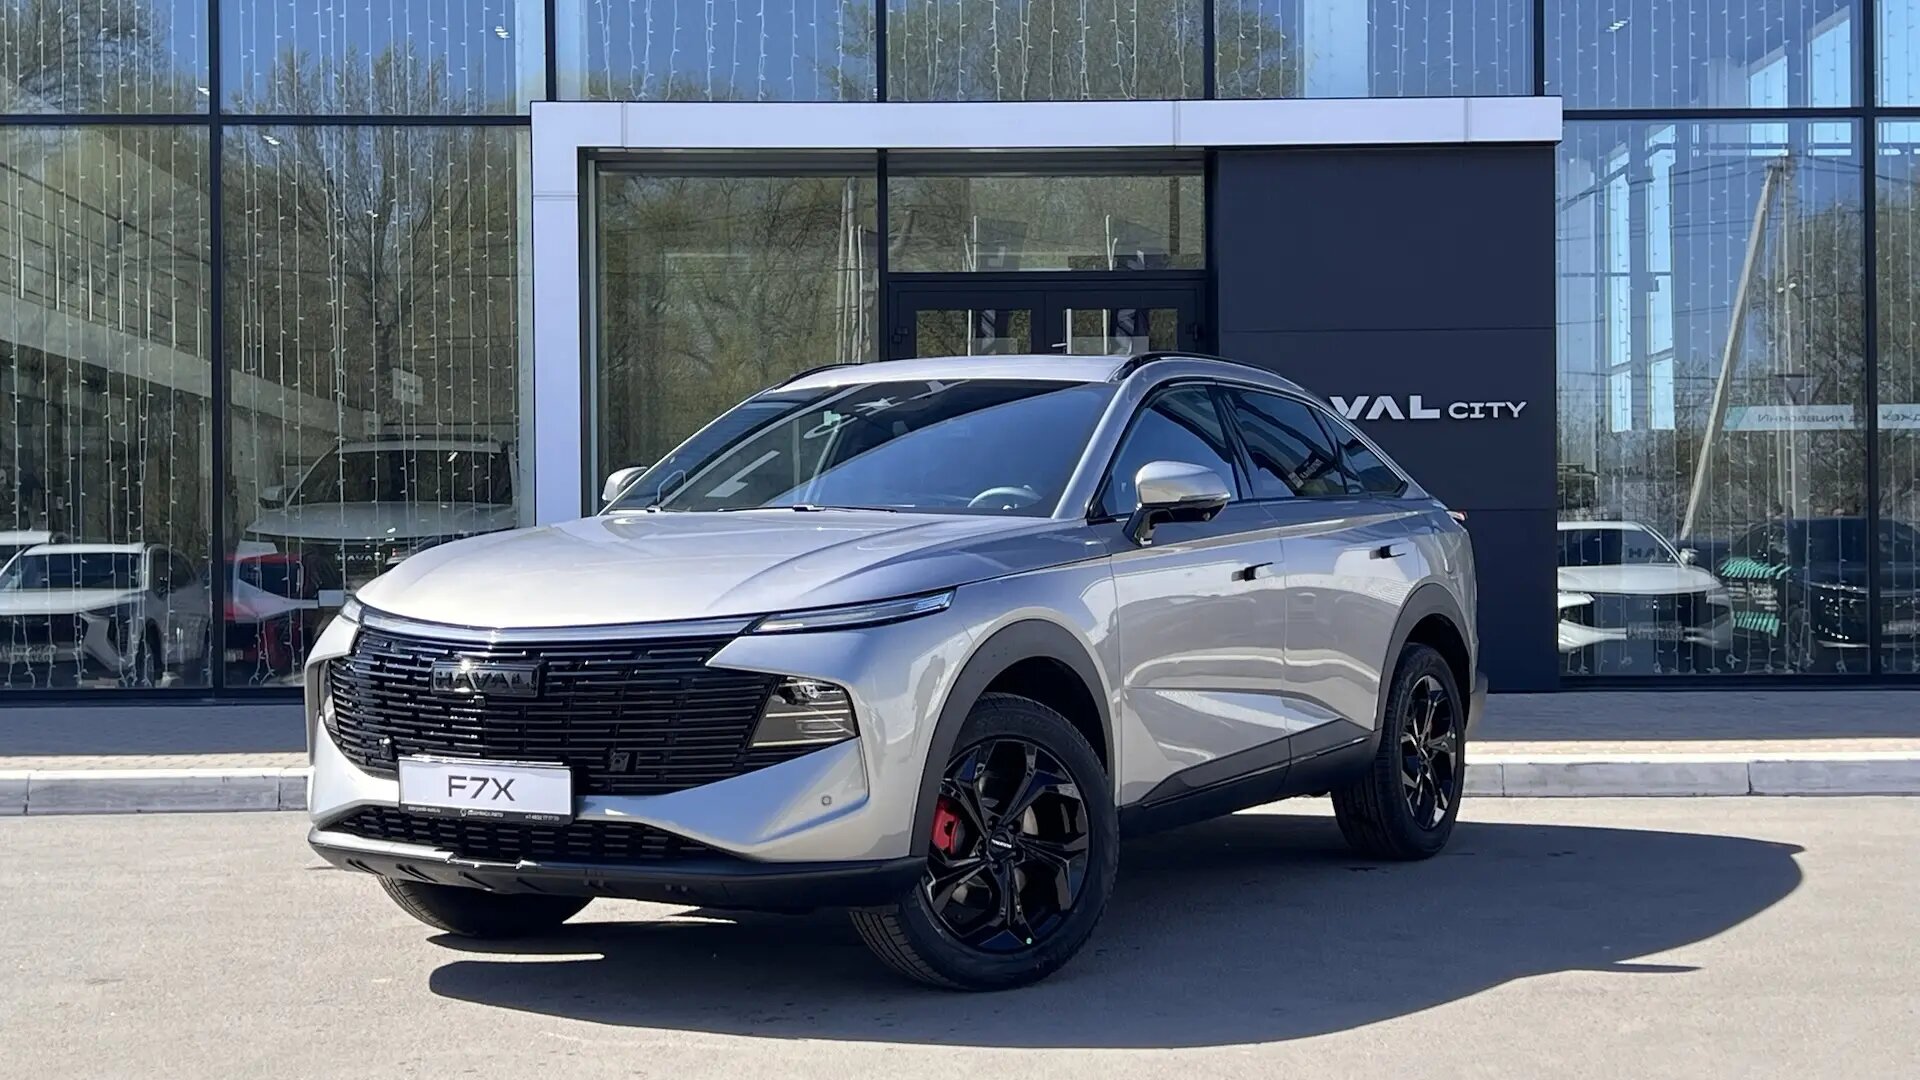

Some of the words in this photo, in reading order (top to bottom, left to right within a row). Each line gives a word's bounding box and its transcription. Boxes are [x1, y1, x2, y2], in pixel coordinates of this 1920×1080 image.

[1328, 395, 1441, 420] VAL
[1448, 401, 1527, 419] CITY
[435, 670, 533, 691] HAVAL
[447, 774, 516, 802] F7X
